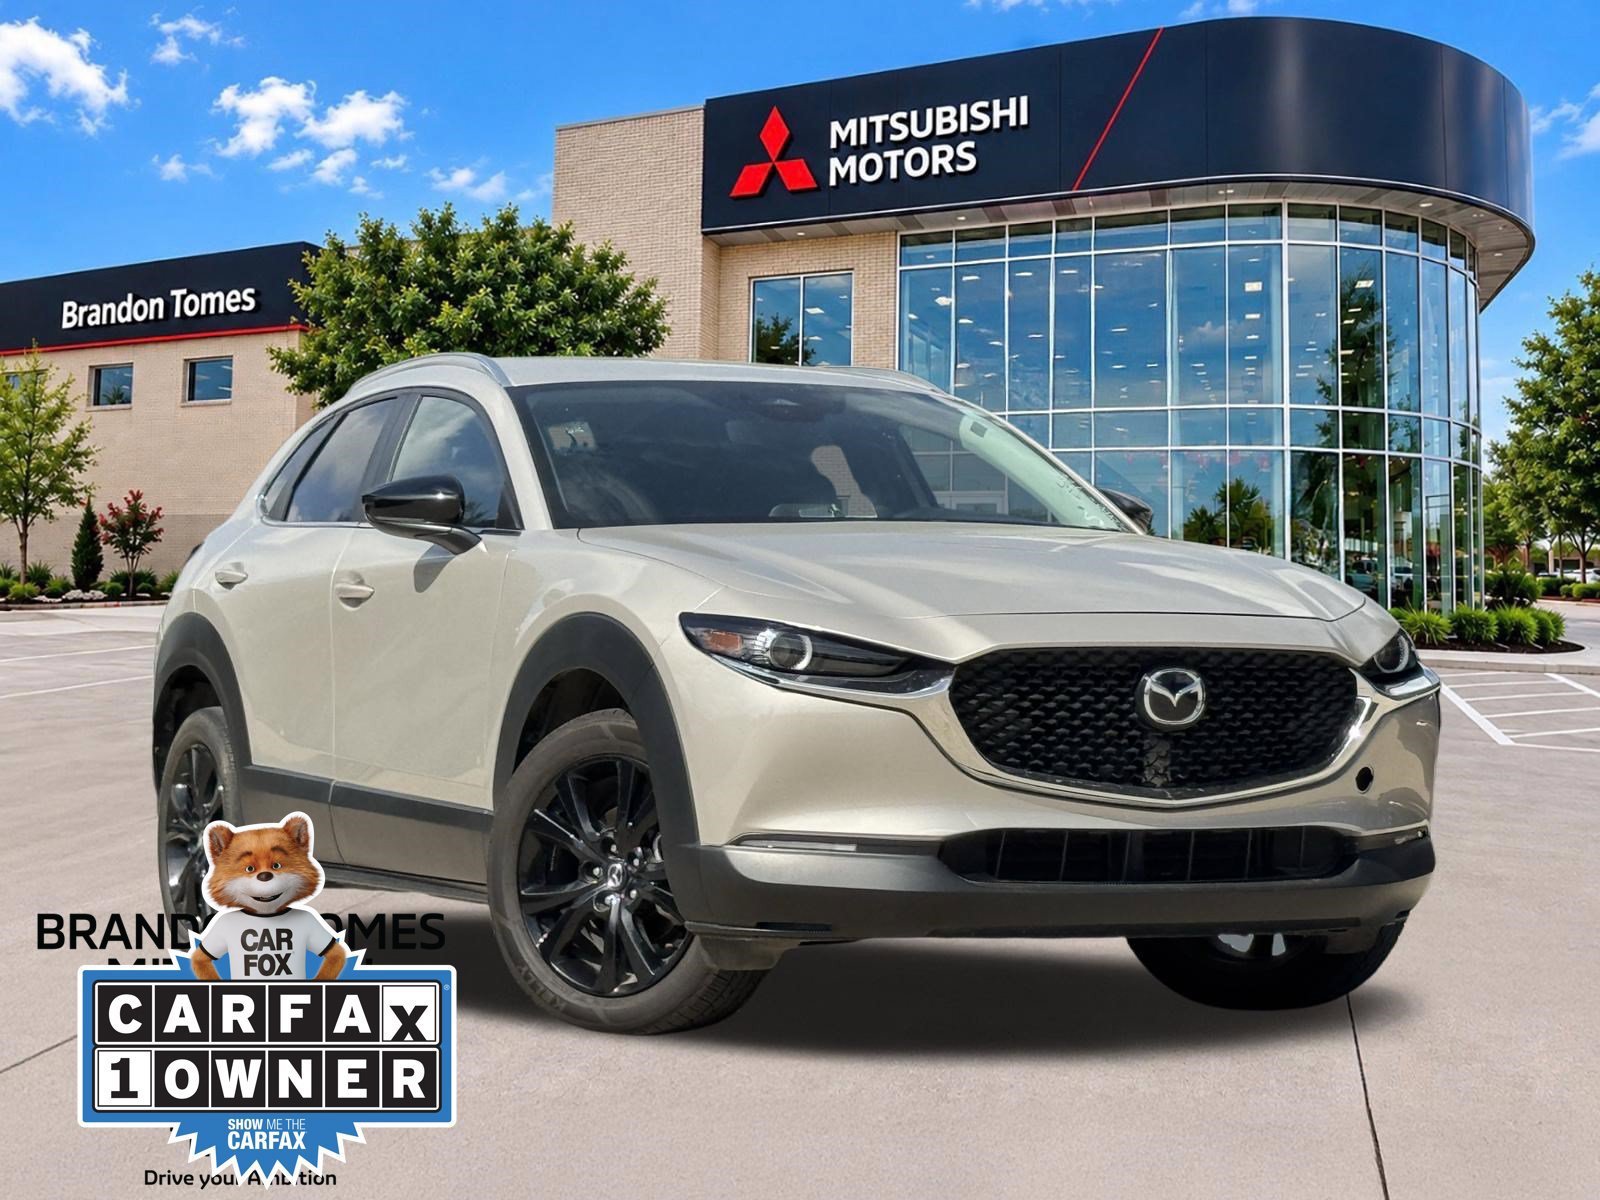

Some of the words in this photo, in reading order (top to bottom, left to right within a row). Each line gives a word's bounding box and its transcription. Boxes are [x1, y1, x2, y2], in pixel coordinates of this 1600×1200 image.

[829, 95, 1029, 149] MITSUBISHI
[829, 141, 977, 187] MOTORS
[61, 293, 165, 329] Brandon
[170, 287, 256, 318] Tomes
